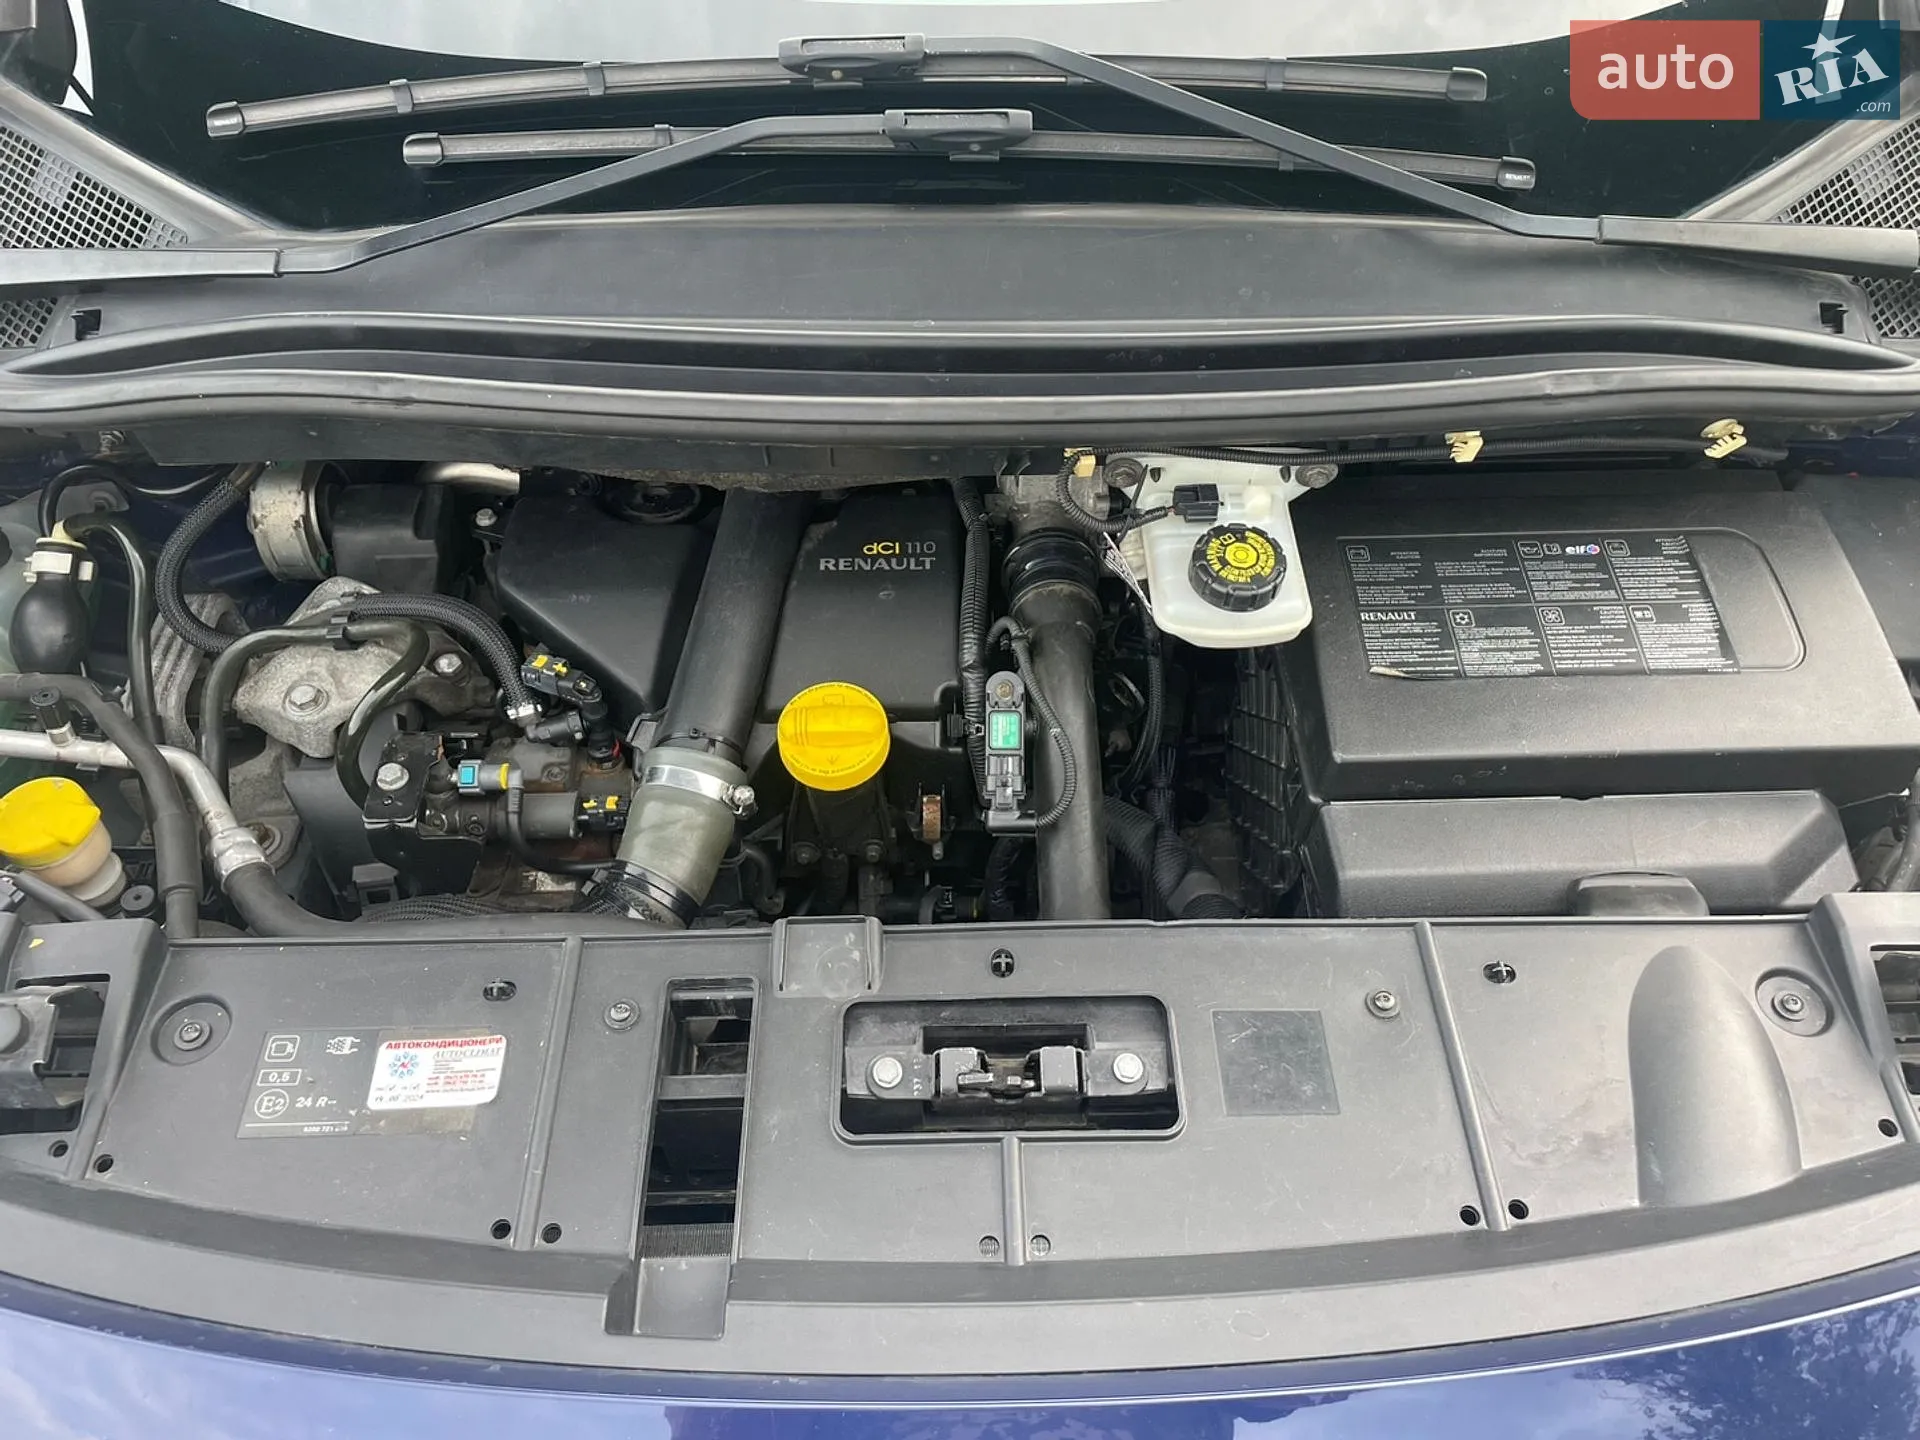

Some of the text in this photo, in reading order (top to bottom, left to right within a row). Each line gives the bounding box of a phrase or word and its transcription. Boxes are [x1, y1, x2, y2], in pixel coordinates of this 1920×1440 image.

[905, 541, 936, 554] 110
[1565, 544, 1586, 554] elf
[819, 557, 936, 571] RENAULT
[1360, 611, 1417, 621] RENAULT
[268, 1071, 291, 1083] 0,5
[260, 1096, 285, 1113] E2
[295, 1096, 313, 1108] 24
